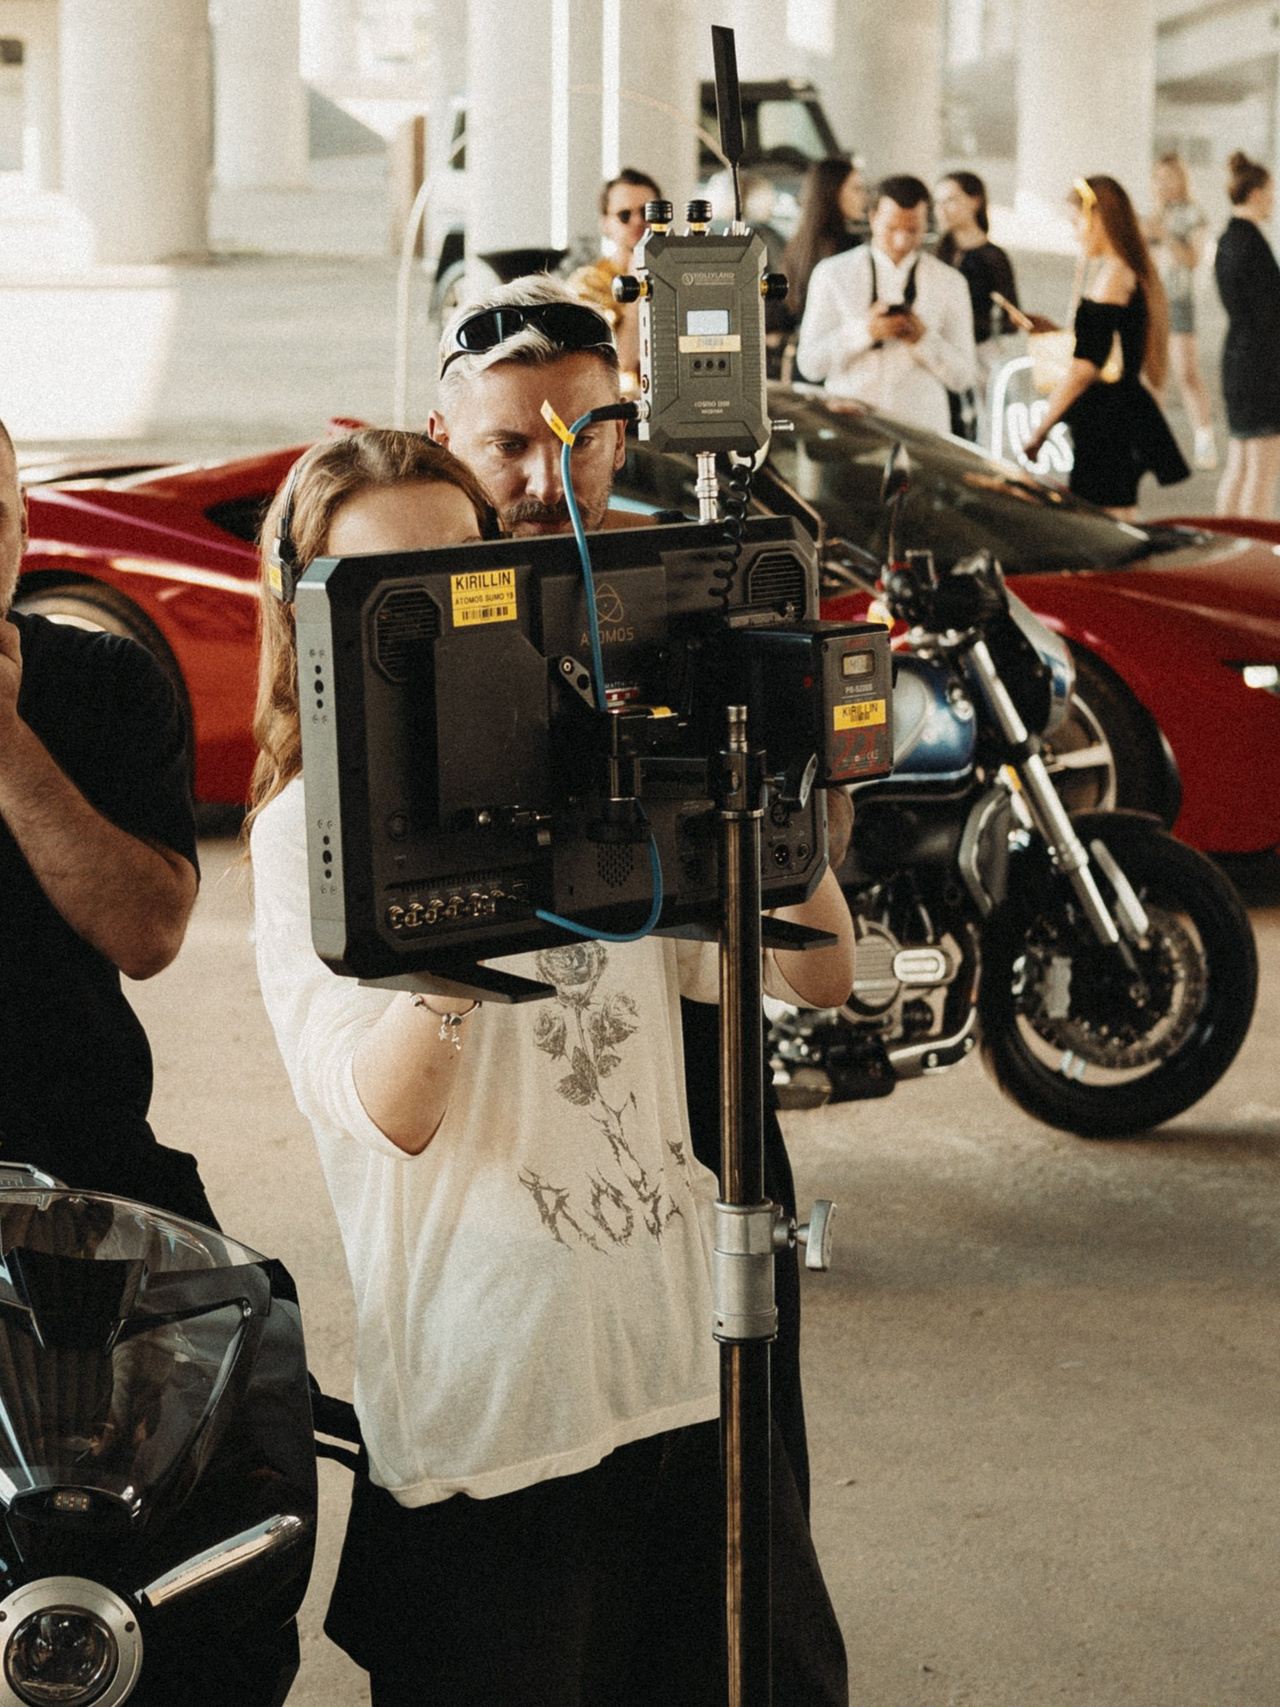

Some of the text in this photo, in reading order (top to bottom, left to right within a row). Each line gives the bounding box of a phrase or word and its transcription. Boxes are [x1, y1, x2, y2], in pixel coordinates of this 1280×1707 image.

[455, 571, 511, 591] KIRILLIN
[455, 595, 484, 605] ATOMOS
[485, 593, 504, 601] SUMO
[580, 627, 634, 646] AOMOS
[841, 702, 878, 718] KIRILLIN
